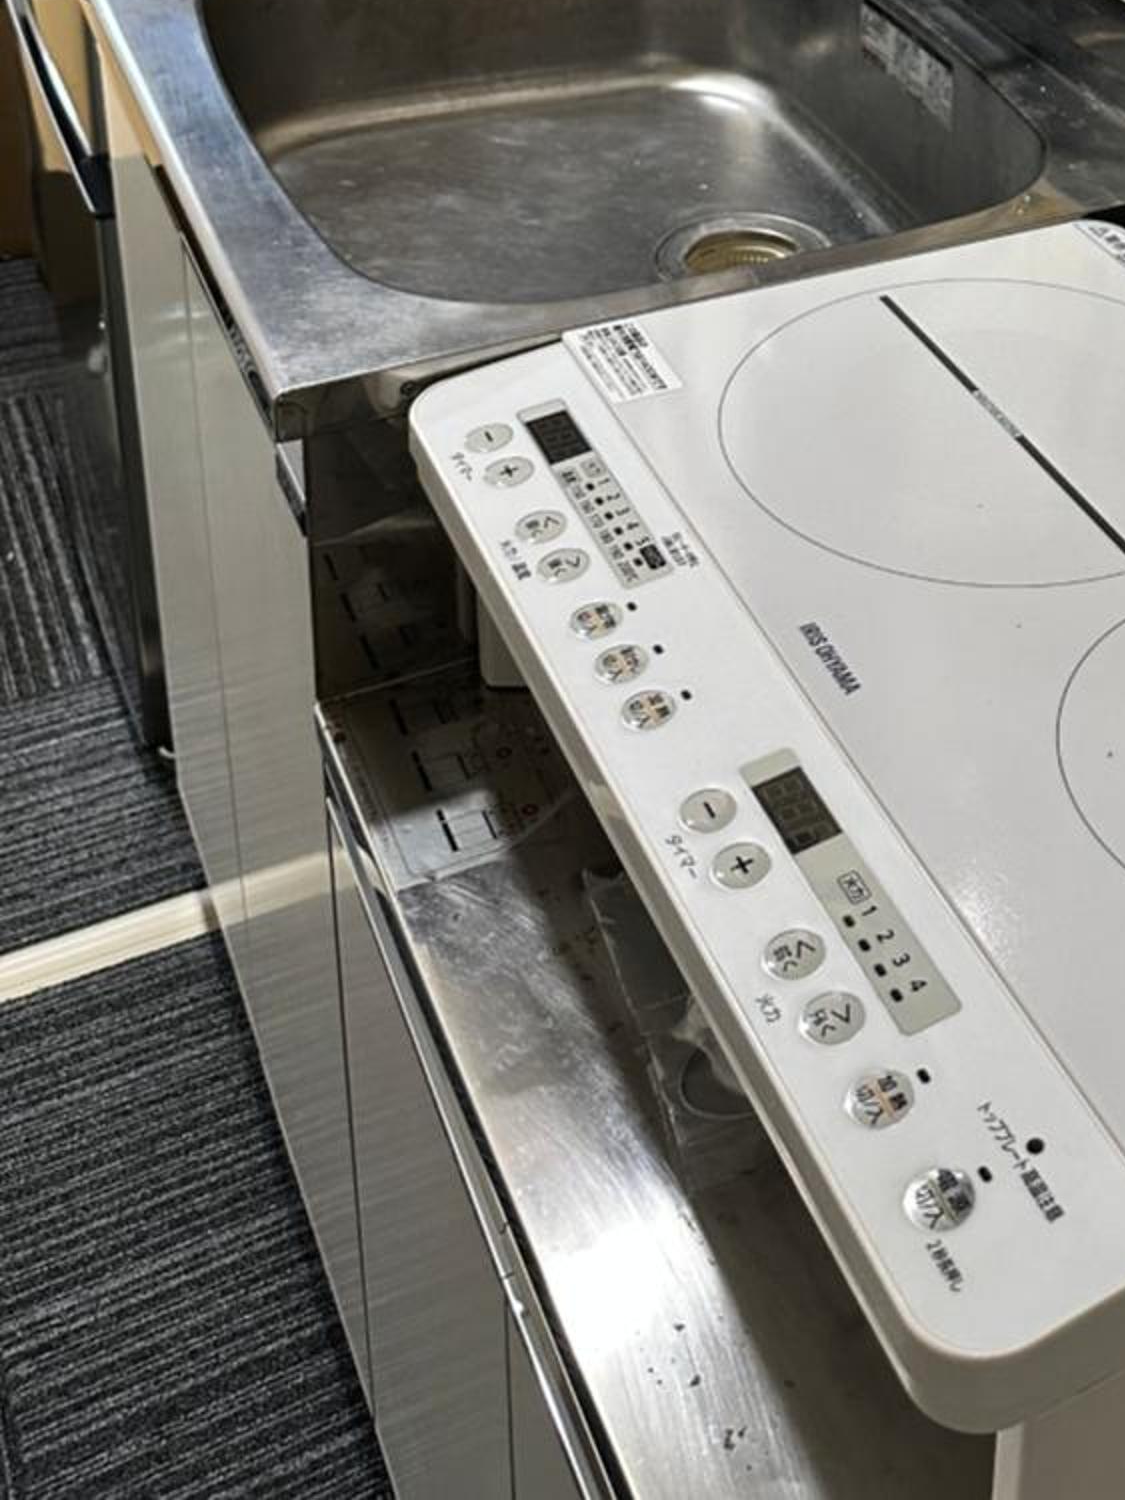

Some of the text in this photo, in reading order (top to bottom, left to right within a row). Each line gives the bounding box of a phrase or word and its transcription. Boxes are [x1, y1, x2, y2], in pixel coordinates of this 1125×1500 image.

[607, 492, 620, 501] 2
[615, 507, 630, 517] 3
[626, 521, 639, 531] 4
[665, 834, 697, 879] タイマー
[862, 905, 877, 916] 1
[876, 929, 895, 944] 2
[892, 952, 911, 967] 3
[910, 980, 928, 992] 4
[755, 993, 782, 1023] 火力
[977, 1101, 1065, 1224] トッププレート高温注意
[916, 1184, 944, 1229] 切/入
[926, 1238, 963, 1293] 2秒長押し
